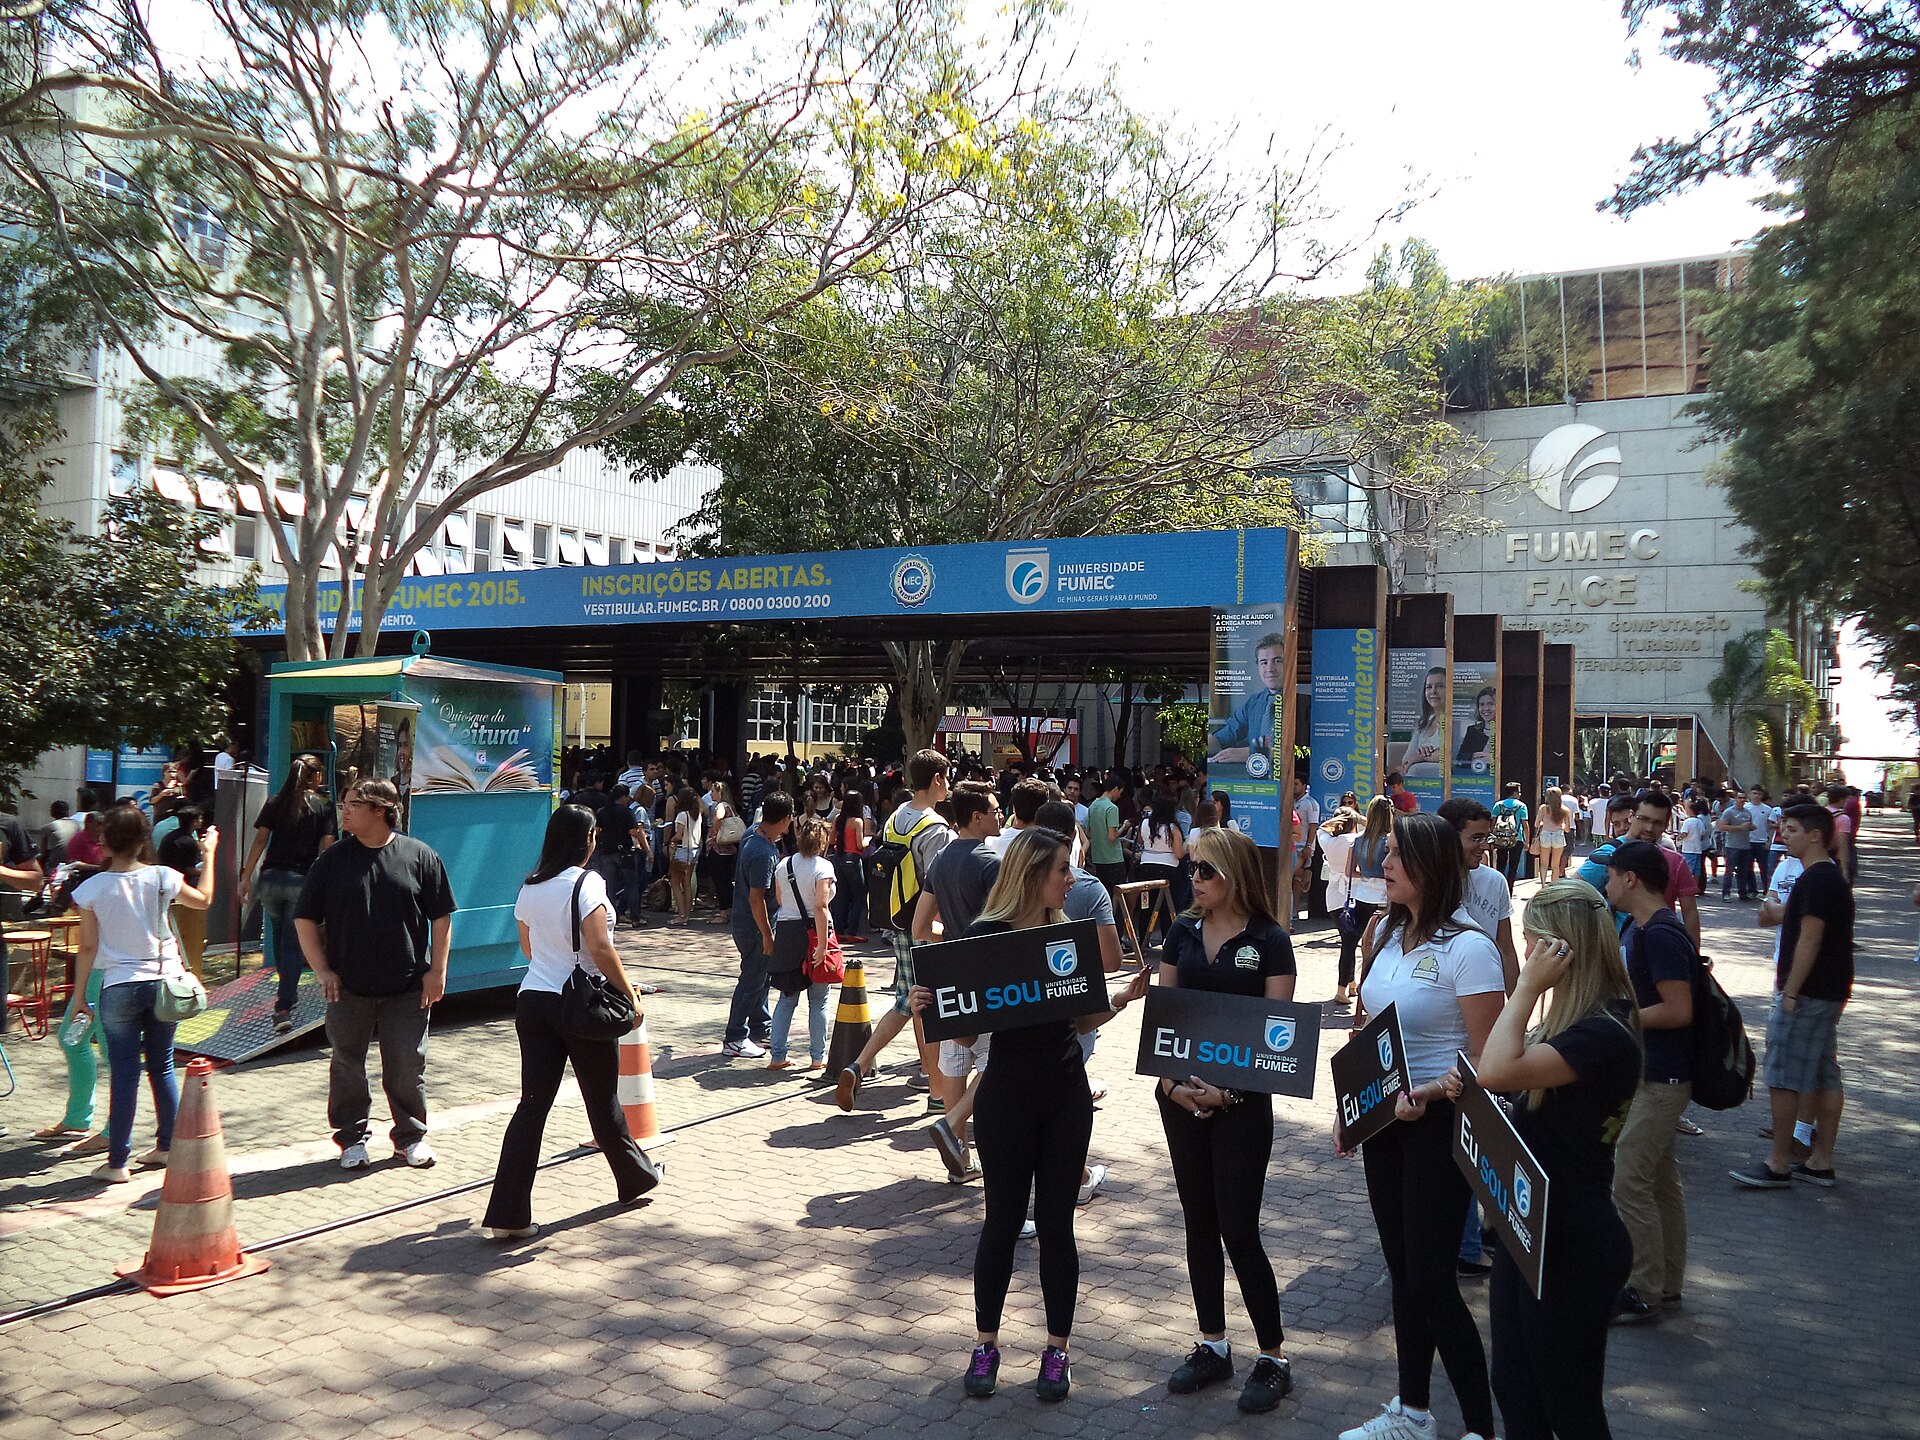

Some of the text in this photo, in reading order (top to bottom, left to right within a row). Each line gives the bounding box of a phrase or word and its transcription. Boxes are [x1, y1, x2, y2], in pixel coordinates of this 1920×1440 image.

[1506, 528, 1660, 563] FUMEC
[897, 561, 928, 578] UNIVERSIDADE
[1058, 561, 1145, 575] UNIVERSIDADE
[582, 563, 832, 598] INSCRIÇÕES ABERTAS.
[904, 576, 922, 586] MEC
[1057, 575, 1115, 591] FUMEC
[1525, 573, 1638, 607] FACE
[466, 579, 527, 605] 2015.
[897, 585, 928, 601] CREDENCIADA
[1066, 595, 1086, 603] MINAS
[1134, 593, 1158, 601] MUNDO
[583, 594, 831, 616] VESTIBULAR.FUMEC.BR / 0800 0300 200
[1609, 614, 1731, 634] COMPUTAÇÃO
[1623, 639, 1702, 652] TURISMO
[490, 708, 506, 723] da
[1271, 694, 1283, 782] reconhecimento
[1045, 976, 1087, 990] UNIVERSIDADE
[1046, 982, 1089, 999] FUMEC
[936, 980, 1042, 1019] Eu sou
[1154, 1027, 1251, 1068] Eu sou
[1255, 1052, 1298, 1063] UNIVERSIDADE
[1254, 1058, 1298, 1074] FUMEC
[1382, 1076, 1402, 1098] FUMEC
[1342, 1079, 1383, 1127] Eu sou
[1460, 1112, 1508, 1216] Eu sou
[1508, 1210, 1532, 1254] FUMEC
